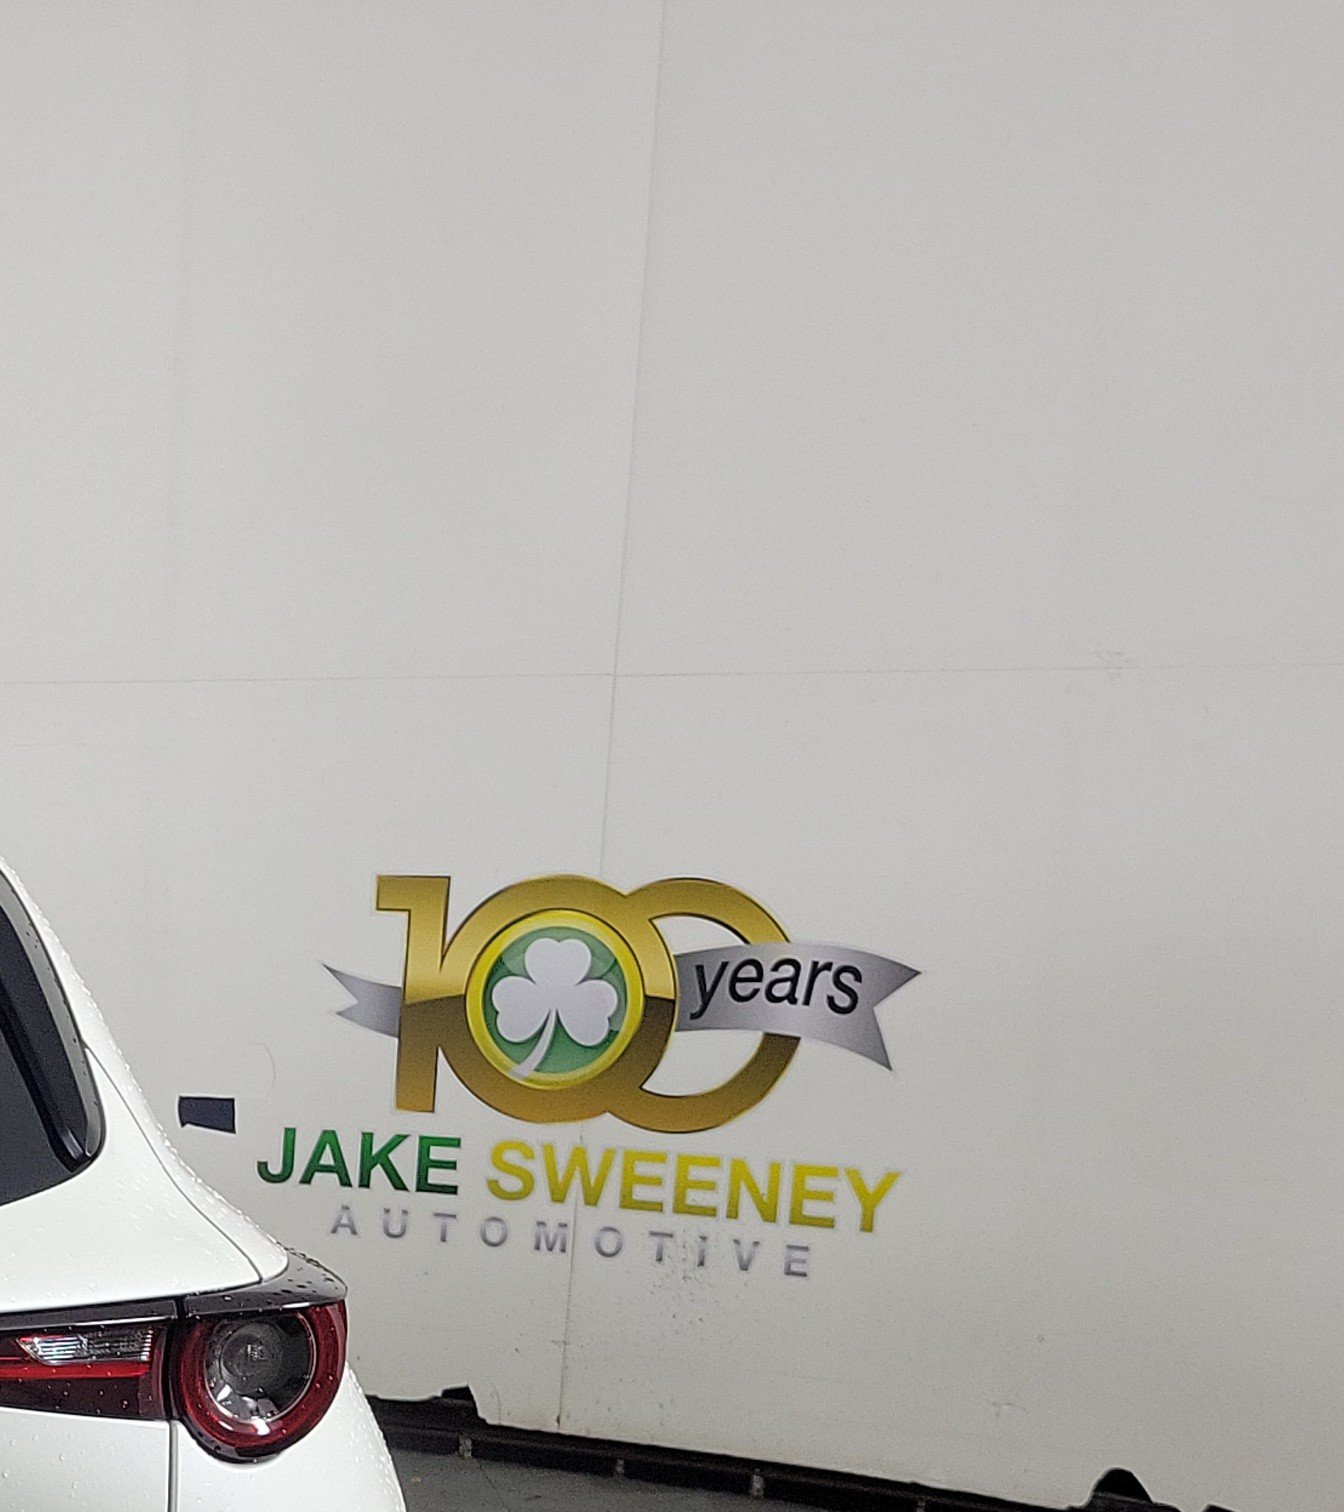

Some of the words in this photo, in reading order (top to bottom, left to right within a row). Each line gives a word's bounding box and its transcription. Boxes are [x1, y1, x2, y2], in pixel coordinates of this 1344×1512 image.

[375, 873, 801, 1134] 100
[688, 955, 862, 1021] years
[257, 1126, 462, 1196] JAKE
[486, 1139, 901, 1233] SWEENEY
[330, 1204, 811, 1278] AUTOMOTIVE
